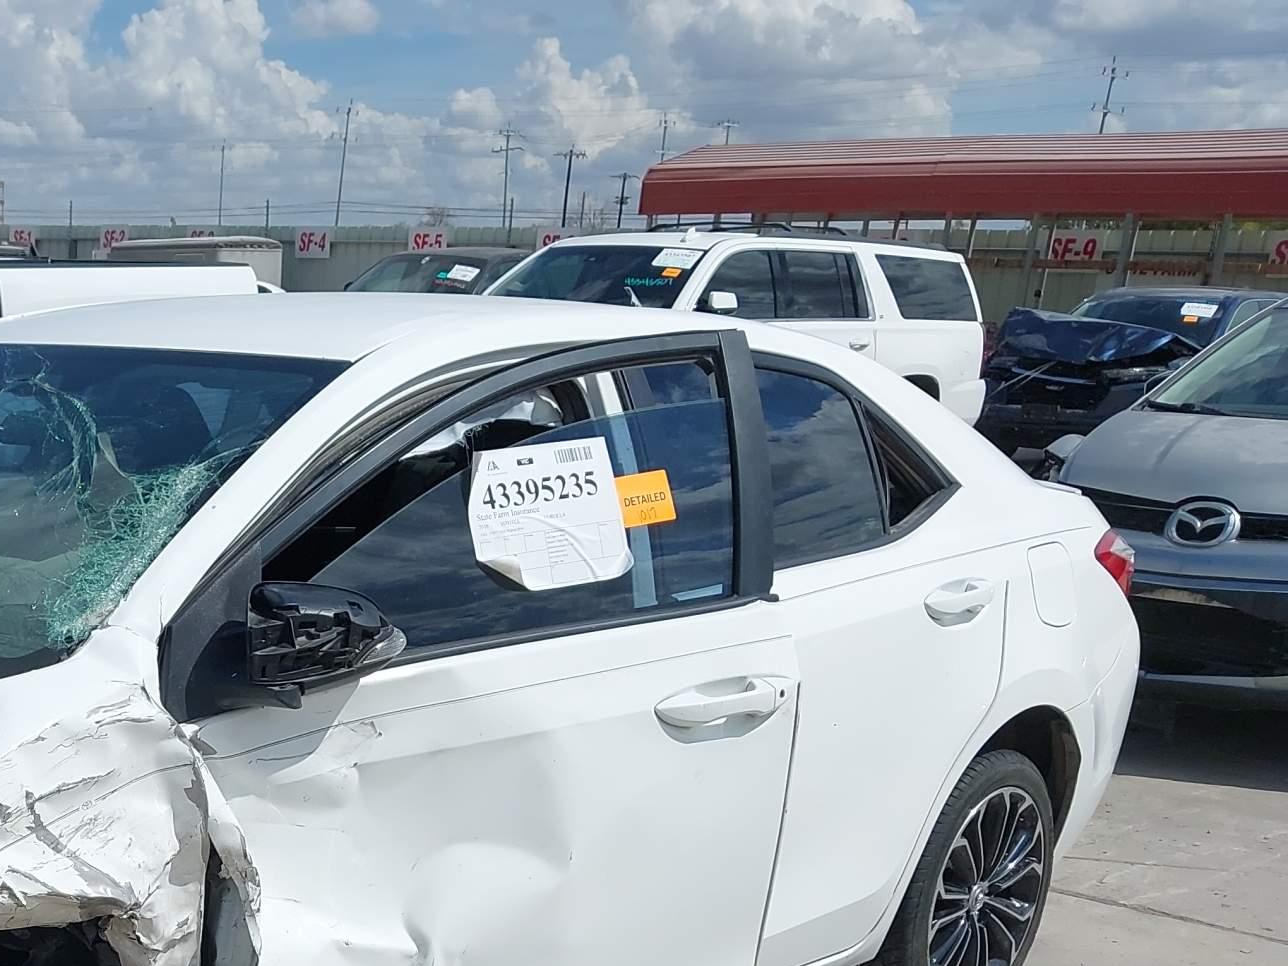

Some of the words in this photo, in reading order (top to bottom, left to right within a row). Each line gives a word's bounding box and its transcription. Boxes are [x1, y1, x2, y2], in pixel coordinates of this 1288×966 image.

[299, 232, 327, 252] SF-4
[413, 233, 443, 249] SF-5
[1052, 238, 1097, 260] SF-9
[482, 471, 598, 510] 43395235
[623, 491, 666, 507] DETAILED
[493, 510, 510, 519] Farm
